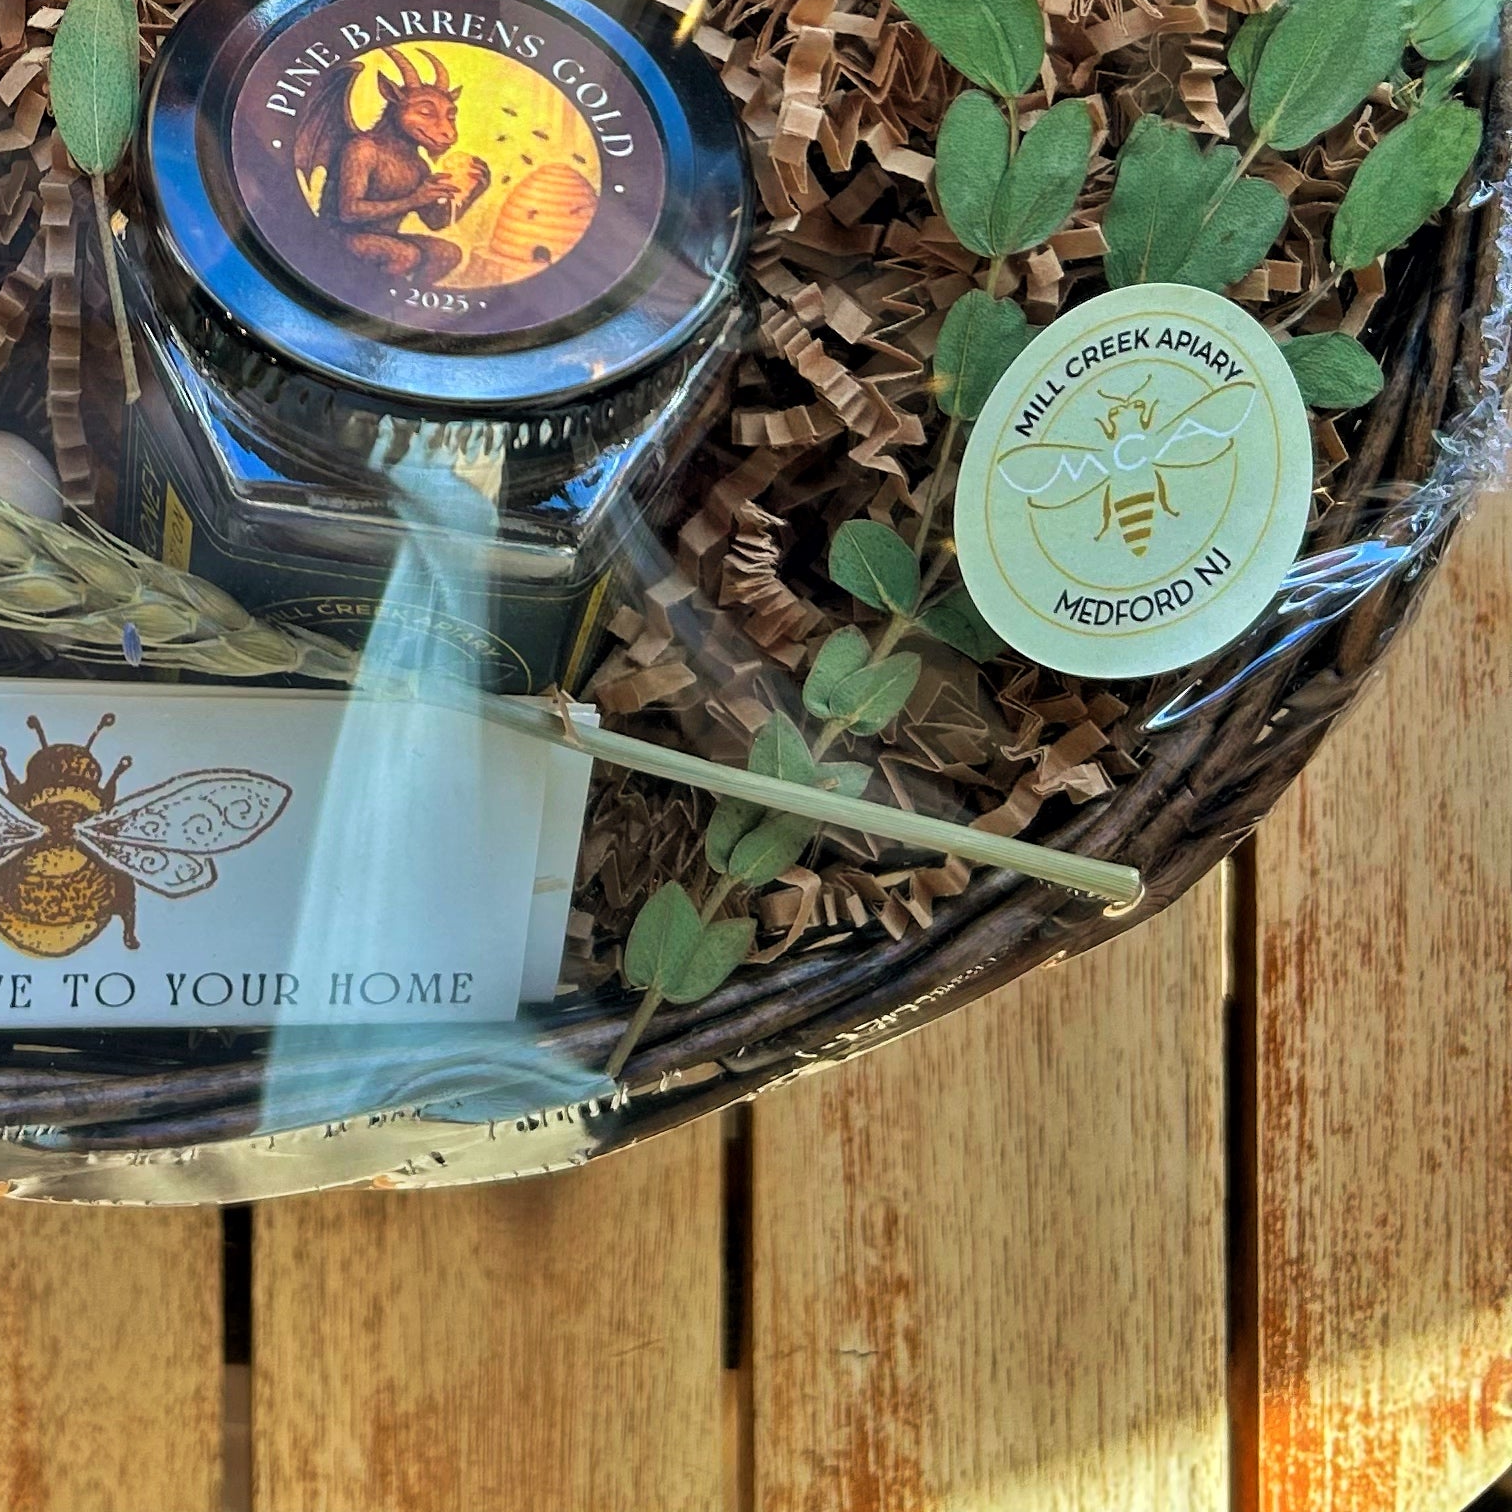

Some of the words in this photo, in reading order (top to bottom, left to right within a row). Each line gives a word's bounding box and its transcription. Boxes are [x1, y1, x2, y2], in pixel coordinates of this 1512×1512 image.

[266, 41, 340, 117] PINE
[340, 9, 545, 59] BARRENS
[552, 58, 635, 158] GOLD
[404, 287, 470, 313] 2025
[1014, 379, 1065, 438] MILL
[1065, 327, 1150, 379] CREEK
[1155, 327, 1244, 382] APIARY
[140, 447, 161, 552] ONEY
[265, 605, 314, 622] ILL
[1053, 578, 1193, 626] MEDFORD
[1194, 547, 1232, 586] NJ
[63, 971, 136, 1008] TO
[167, 971, 300, 1008] YOUR
[328, 971, 474, 1007] HOME
